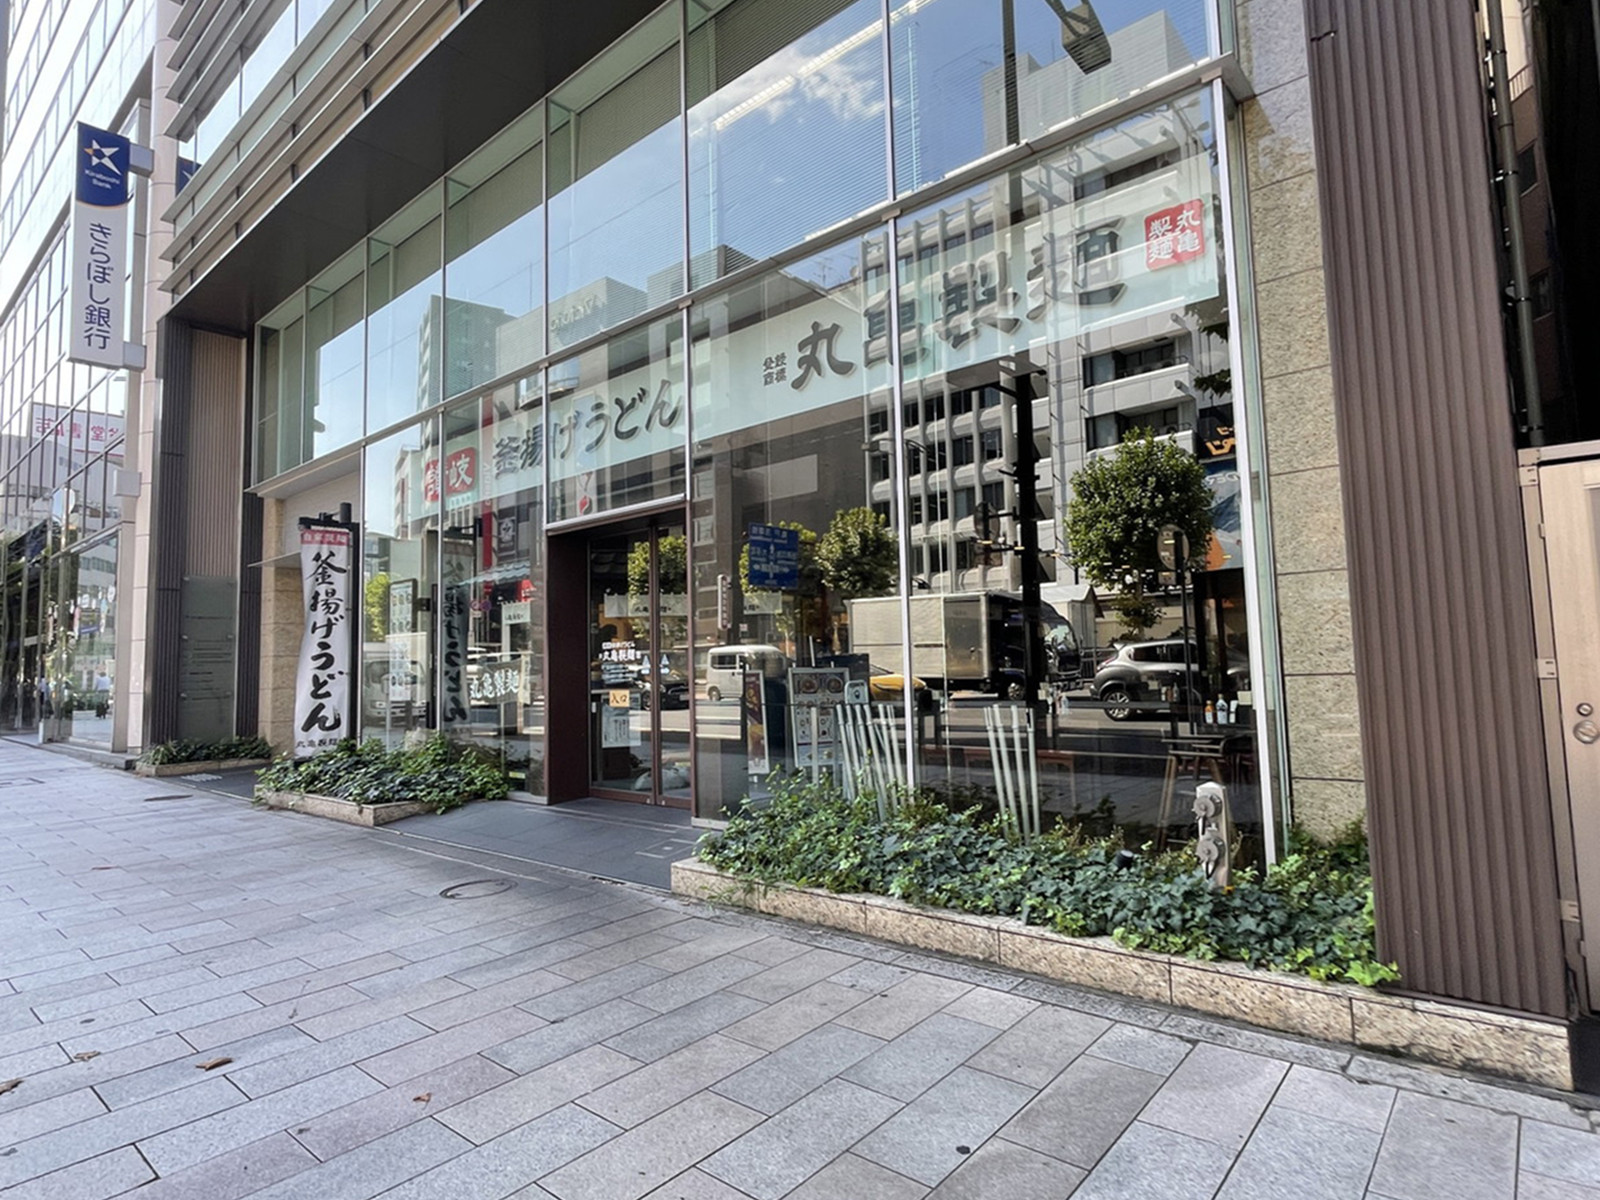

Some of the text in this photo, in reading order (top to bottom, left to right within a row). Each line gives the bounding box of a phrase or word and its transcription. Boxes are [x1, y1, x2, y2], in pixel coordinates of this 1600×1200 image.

[84, 222, 114, 350] きらぼし銀行
[493, 380, 683, 479] 釜揚げうどん
[301, 551, 348, 732] 釜揚げうどん
[470, 669, 519, 698] 丸亀製麺
